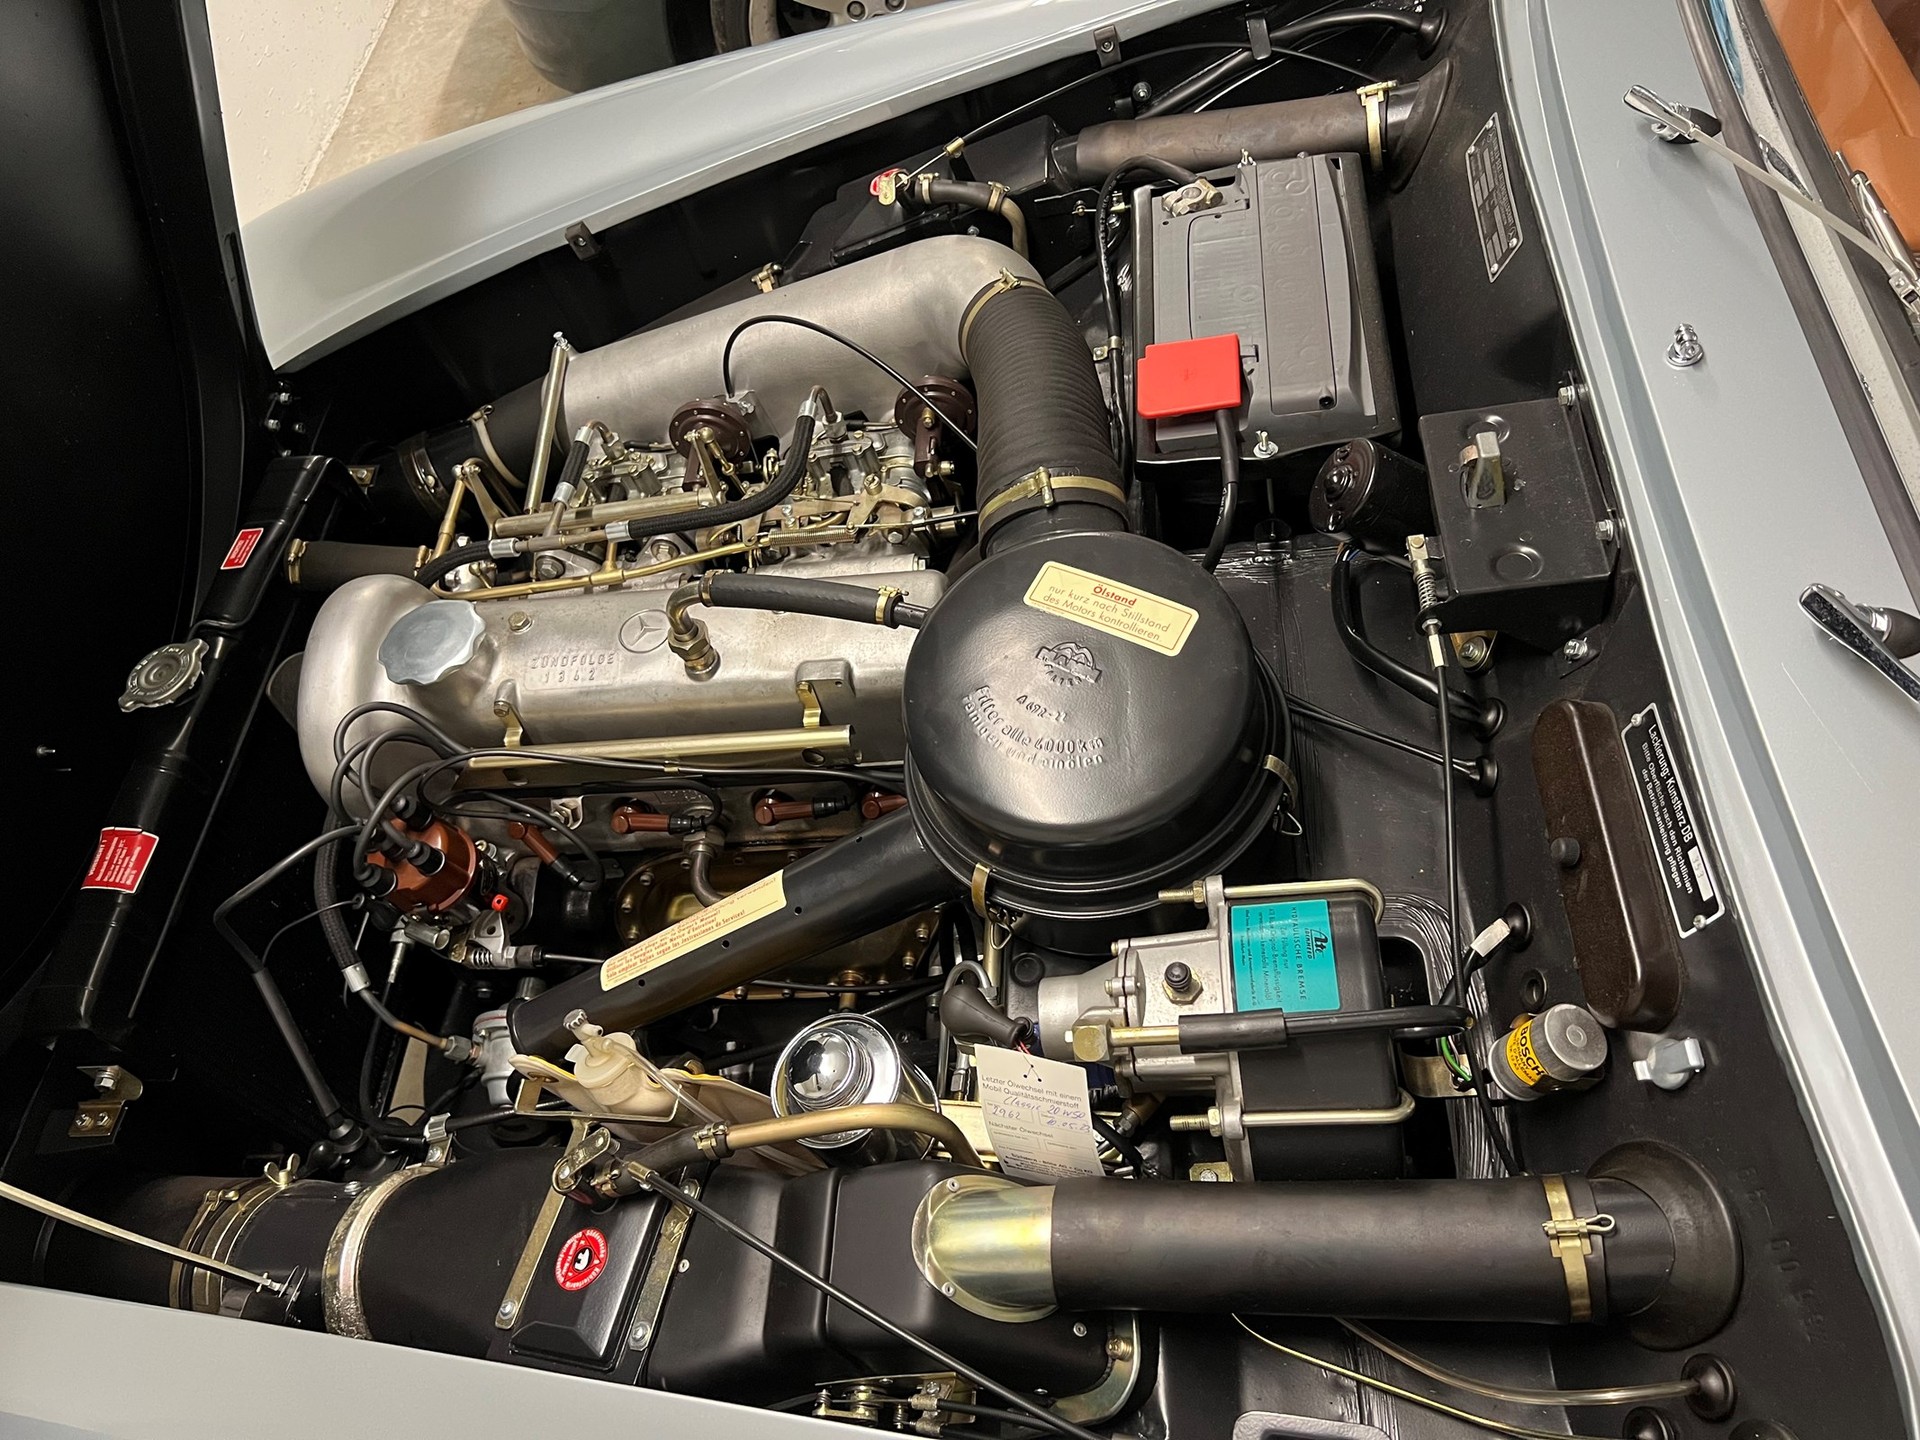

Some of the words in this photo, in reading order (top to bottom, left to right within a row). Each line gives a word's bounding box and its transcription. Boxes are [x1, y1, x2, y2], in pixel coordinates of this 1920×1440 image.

[1042, 592, 1061, 605] des
[1061, 599, 1097, 617] Motors
[1097, 611, 1165, 642] kontrollieren.
[1048, 585, 1065, 595] nur
[1067, 589, 1091, 604] kurz
[1091, 598, 1119, 614] nach
[1120, 607, 1170, 632] Stillstand
[1091, 582, 1138, 607] Ölstand
[1001, 724, 1032, 746] alle
[1648, 724, 1669, 779] Lackierung:
[1666, 775, 1687, 828] Kunstharz
[1681, 822, 1693, 845] DB
[1641, 741, 1651, 763] Bitte
[1648, 760, 1666, 808] Oberfläche
[1662, 805, 1672, 829] nach
[1668, 827, 1678, 847] den
[1674, 844, 1694, 895] Richtlinien
[1641, 766, 1649, 784] der
[1646, 781, 1672, 857] Betriebsanleitung
[1667, 852, 1682, 890] pflegen
[1296, 963, 1307, 1000] BREMSE
[1520, 1026, 1545, 1076] BOSCH
[982, 1082, 1002, 1093] Mobil
[1045, 1089, 1058, 1097] mit
[1059, 1093, 1082, 1101] einem
